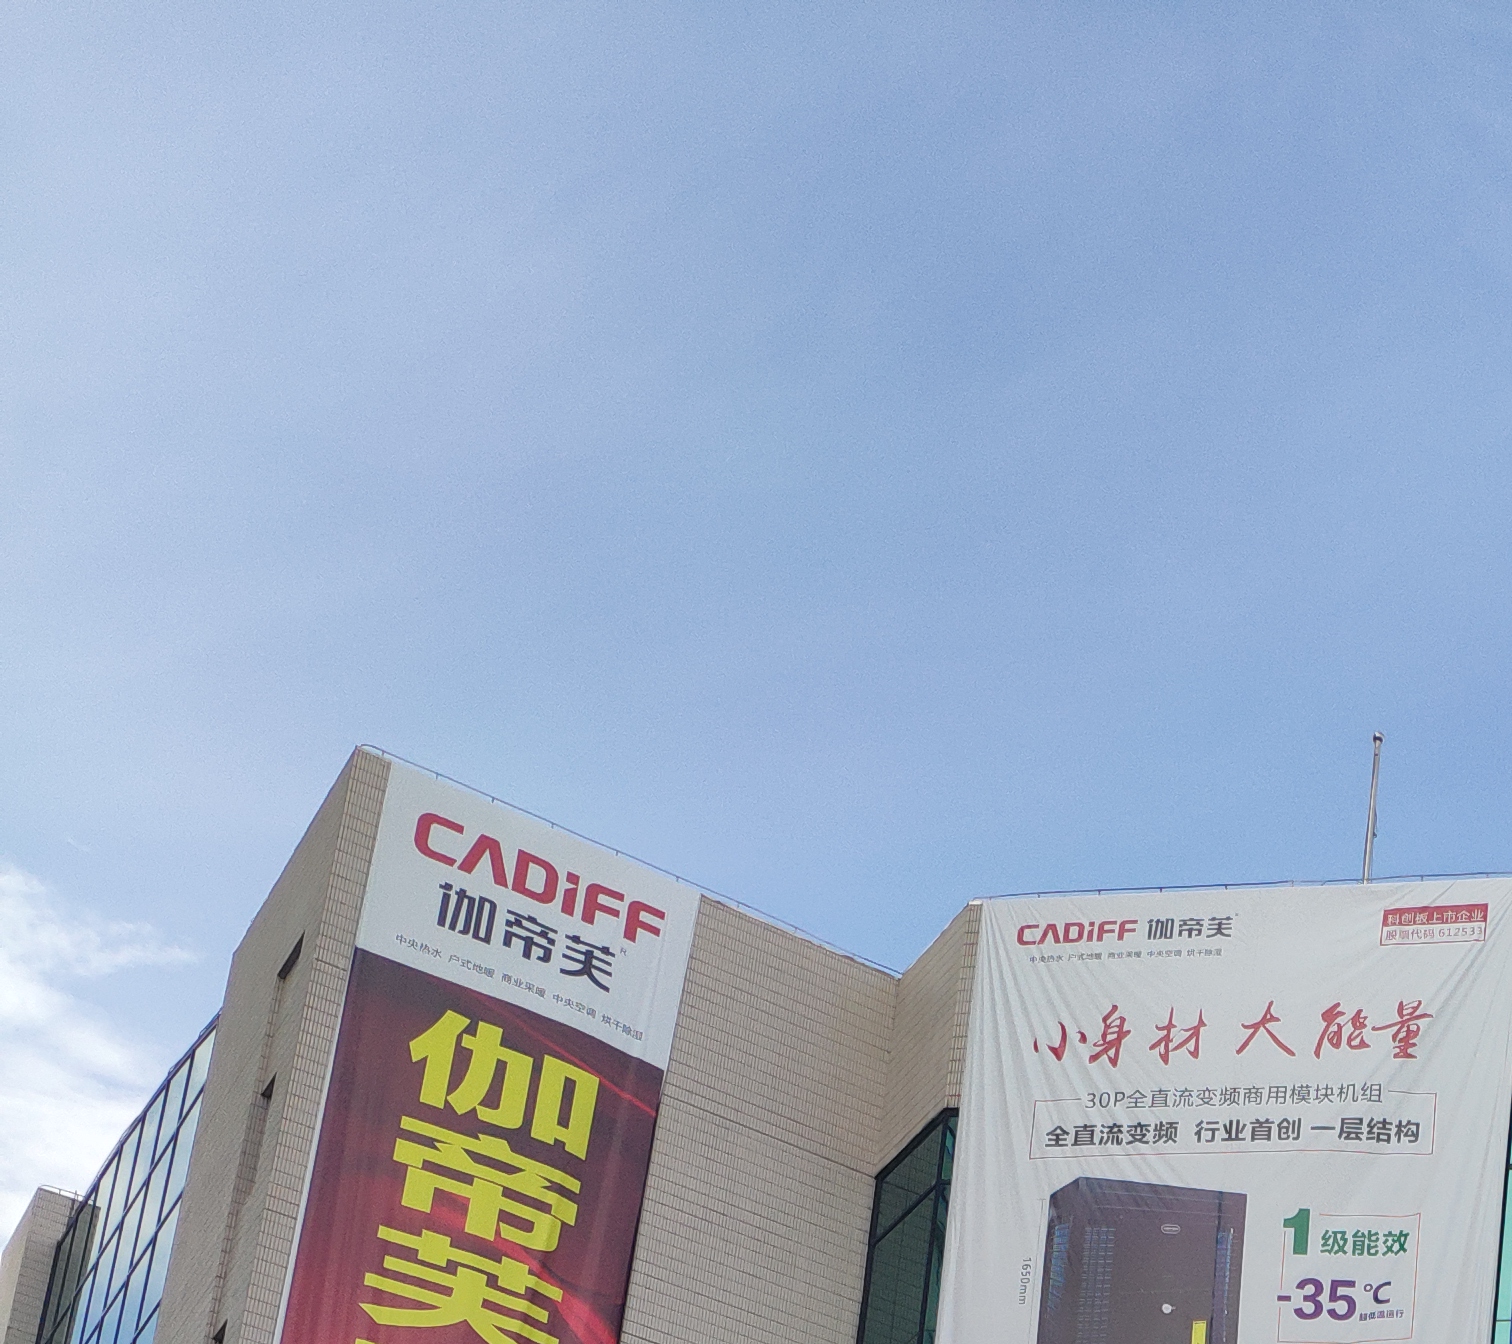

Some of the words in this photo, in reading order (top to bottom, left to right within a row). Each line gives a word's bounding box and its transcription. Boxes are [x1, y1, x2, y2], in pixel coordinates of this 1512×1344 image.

[436, 881, 617, 993] 伽帝芙
[1147, 916, 1233, 941] 伽帝芙
[1084, 1081, 1383, 1110] 30P全直流变频商用模块机组
[1045, 1120, 1180, 1148] 全直流变频
[1194, 1116, 1301, 1144] 行业首创
[1310, 1117, 1421, 1145] 一层结构
[1018, 1257, 1032, 1305] 1650mm
